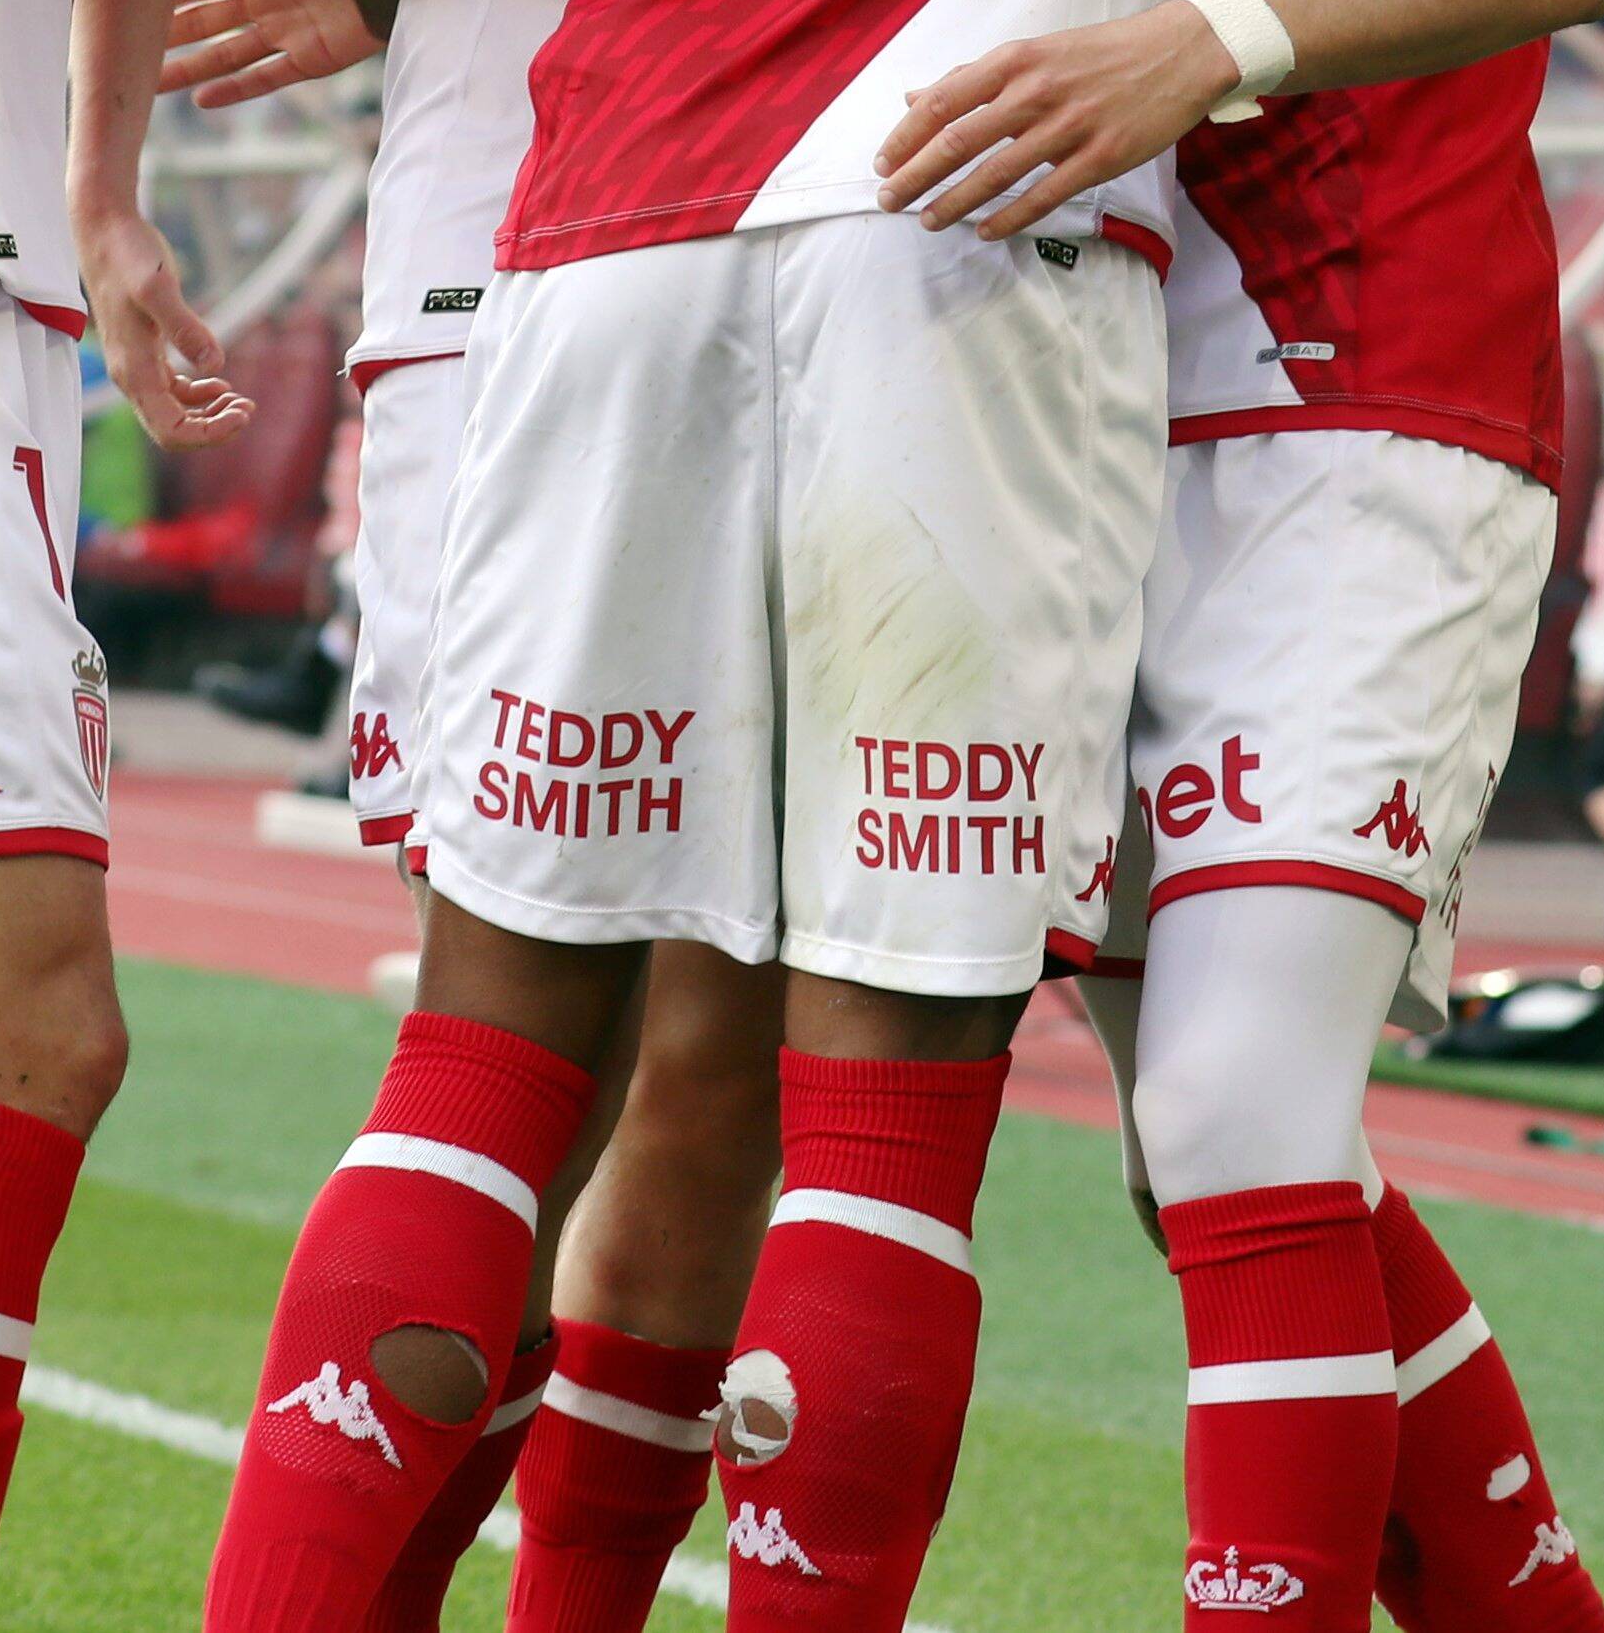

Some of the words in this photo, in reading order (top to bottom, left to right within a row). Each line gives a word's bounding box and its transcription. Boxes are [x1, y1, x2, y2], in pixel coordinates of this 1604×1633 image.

[490, 689, 695, 770] TEDDY
[473, 761, 683, 839] SMITH
[855, 736, 1045, 803] TEDDY
[856, 810, 1045, 875] SMITH
